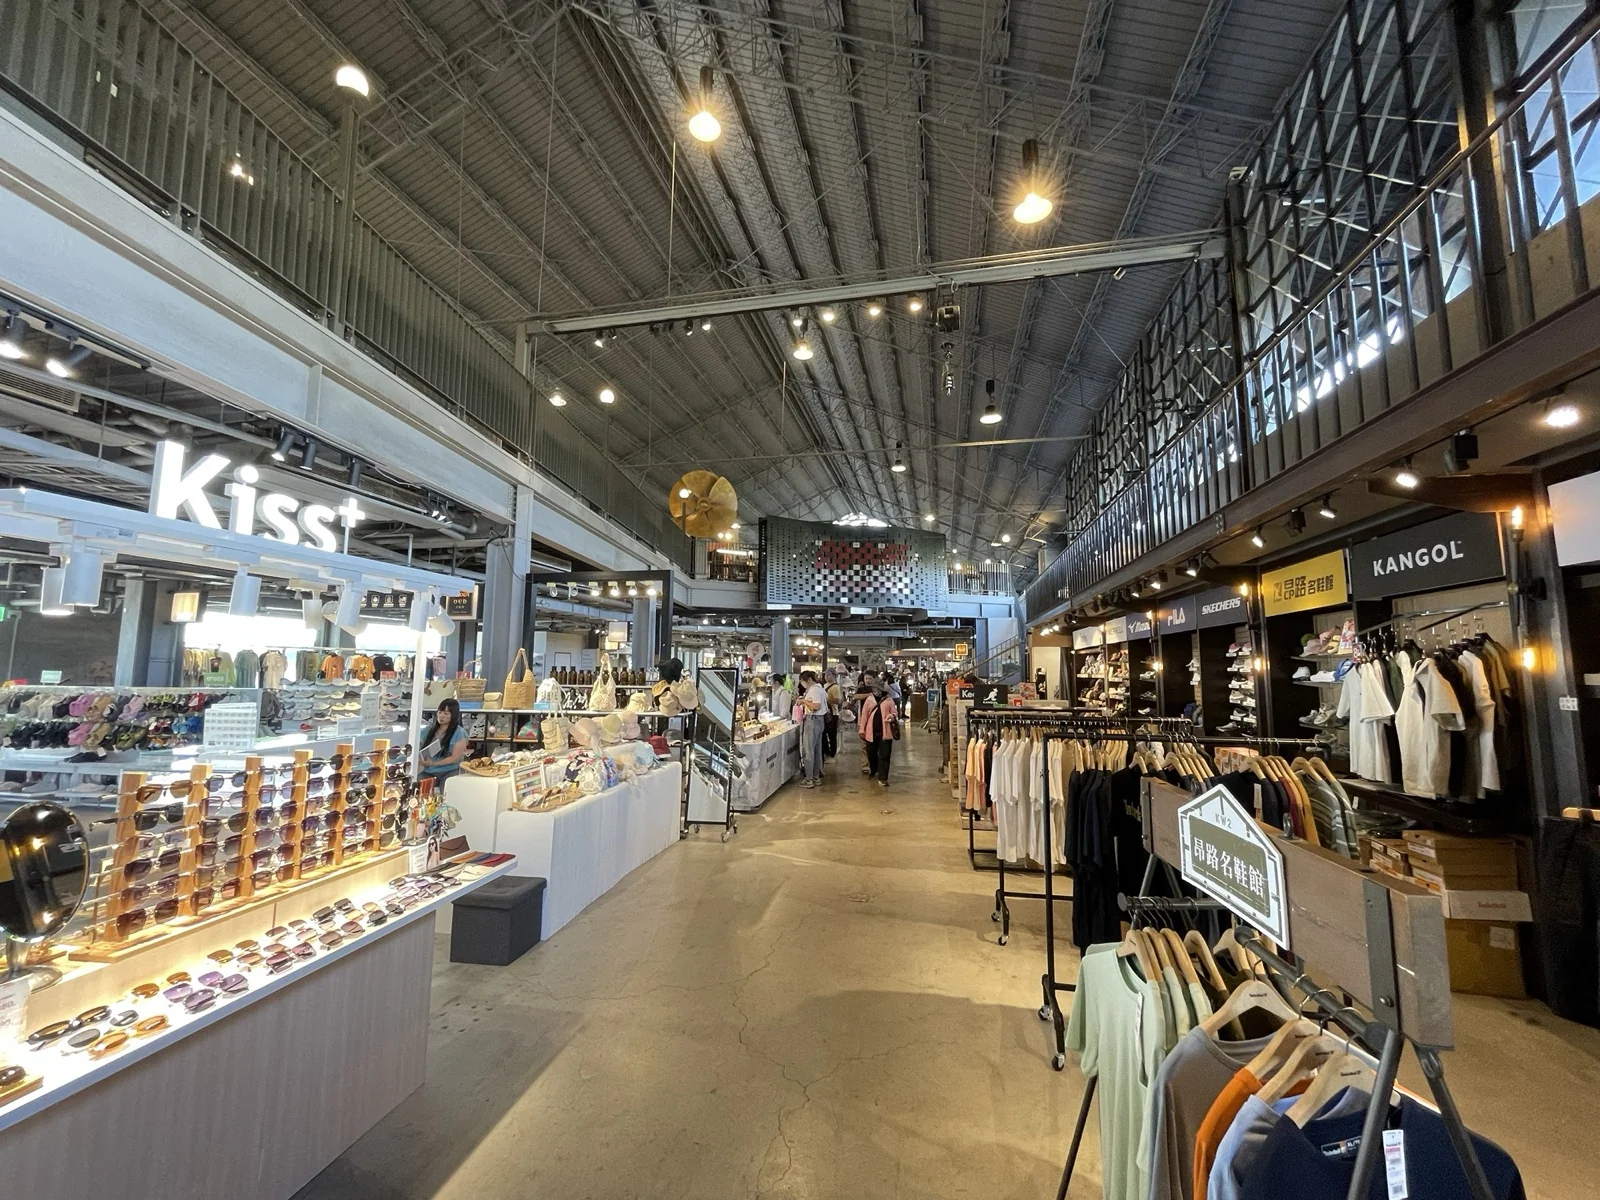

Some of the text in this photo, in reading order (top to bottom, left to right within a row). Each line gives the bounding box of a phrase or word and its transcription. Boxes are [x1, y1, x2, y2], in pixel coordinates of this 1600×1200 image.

[1373, 541, 1464, 576] KANGOL
[1202, 597, 1241, 615] SKECHERS
[1167, 607, 1186, 626] FILA
[1215, 812, 1232, 829] KW2
[1194, 837, 1264, 898] 昂路名鞋館
